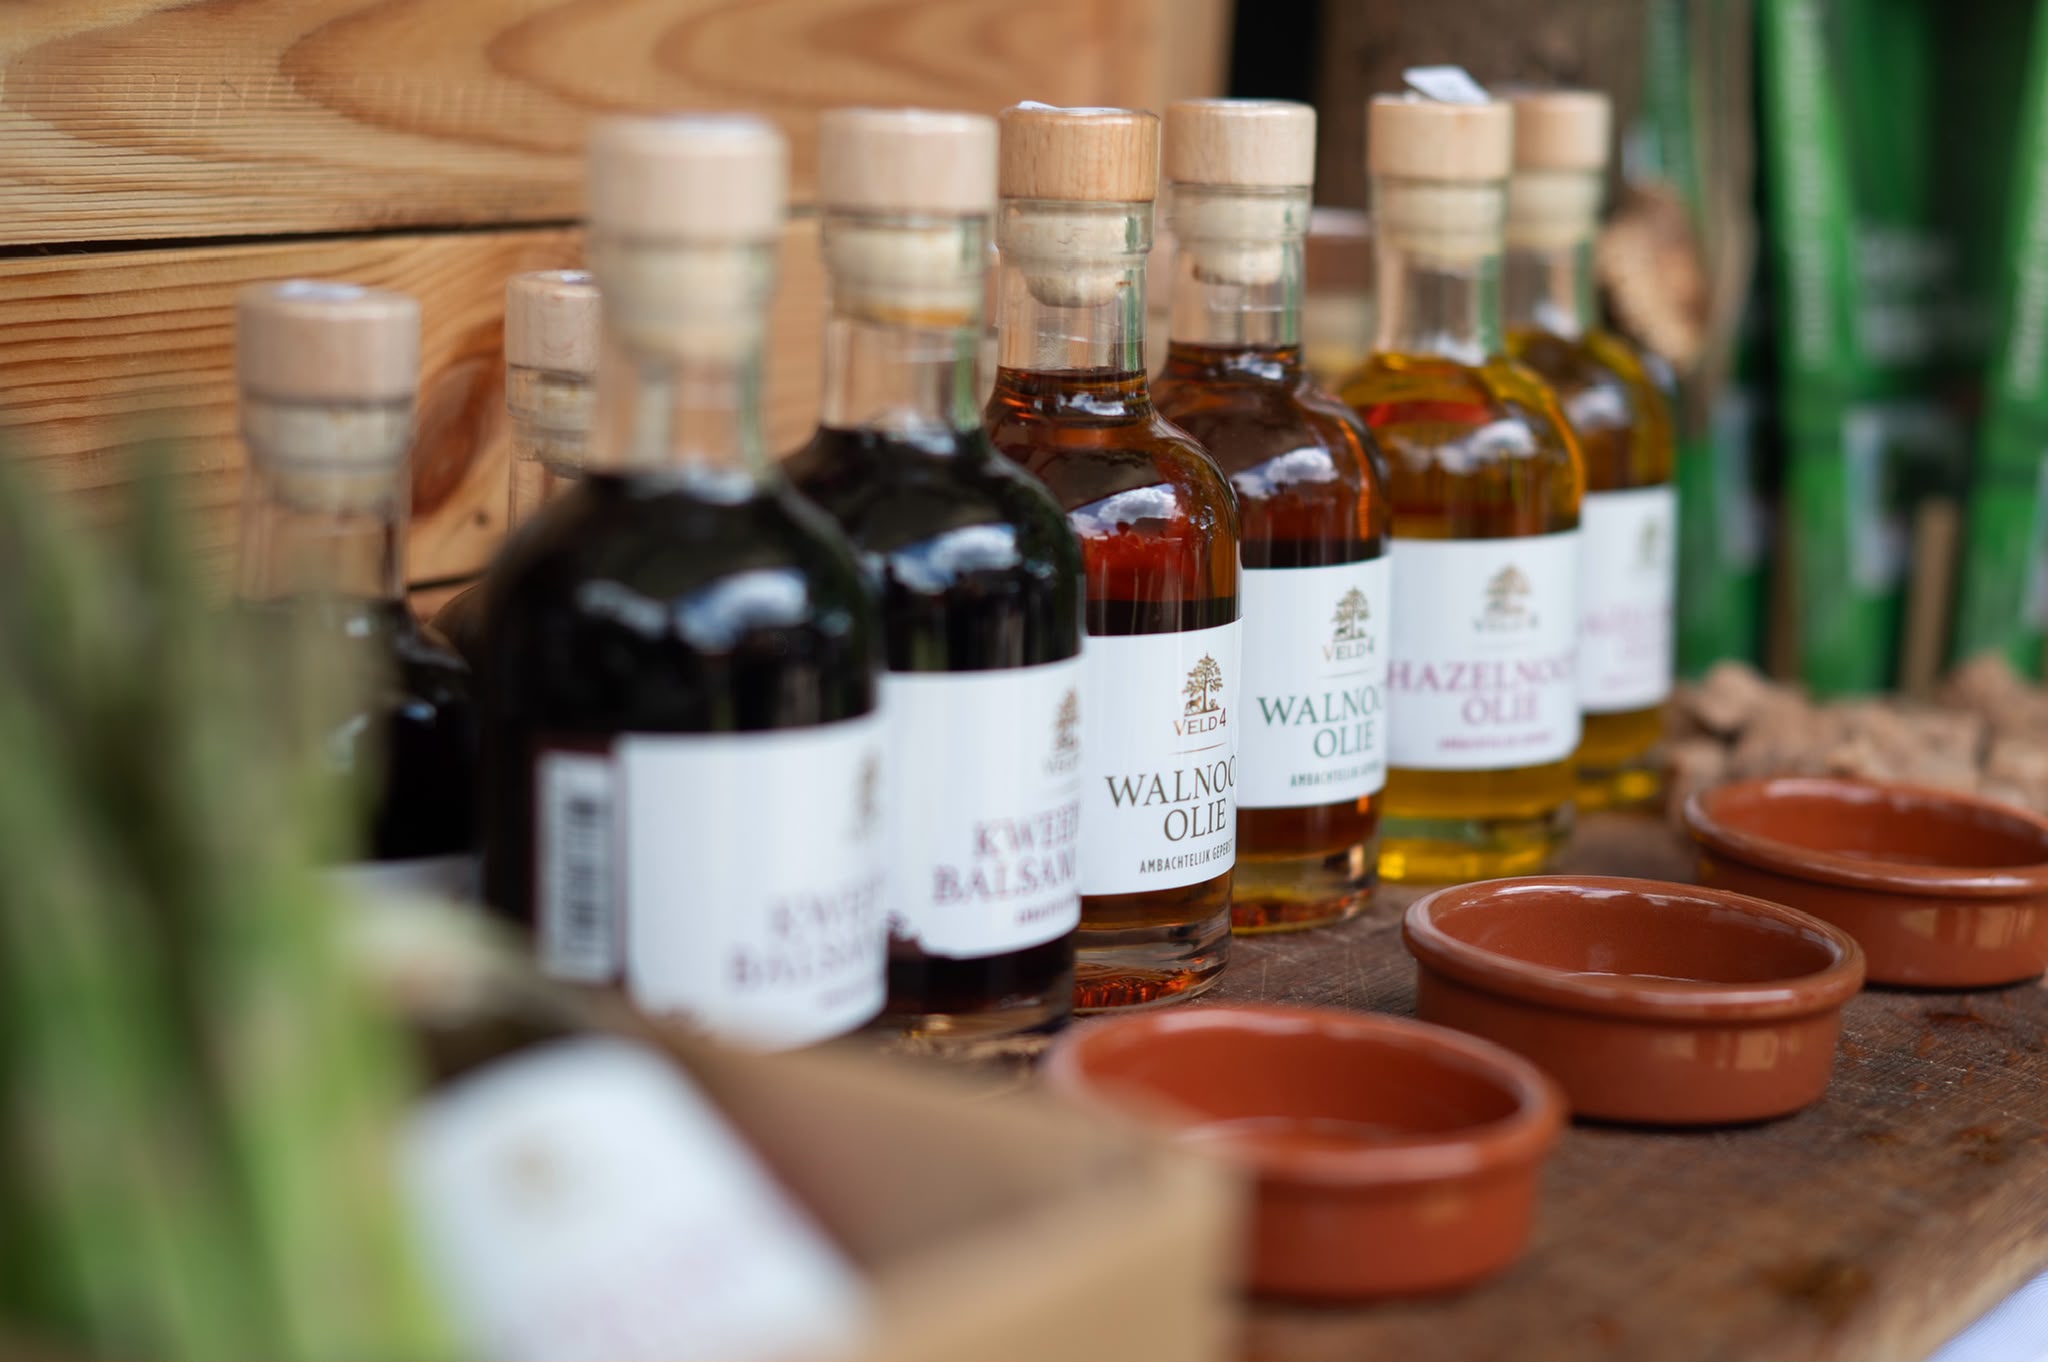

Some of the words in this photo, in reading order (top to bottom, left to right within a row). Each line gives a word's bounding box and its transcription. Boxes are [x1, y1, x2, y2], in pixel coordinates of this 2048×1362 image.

[1313, 720, 1376, 759] OLIE
[1164, 798, 1227, 842] OLIE
[1140, 849, 1211, 874] AMBACHTELIJK
